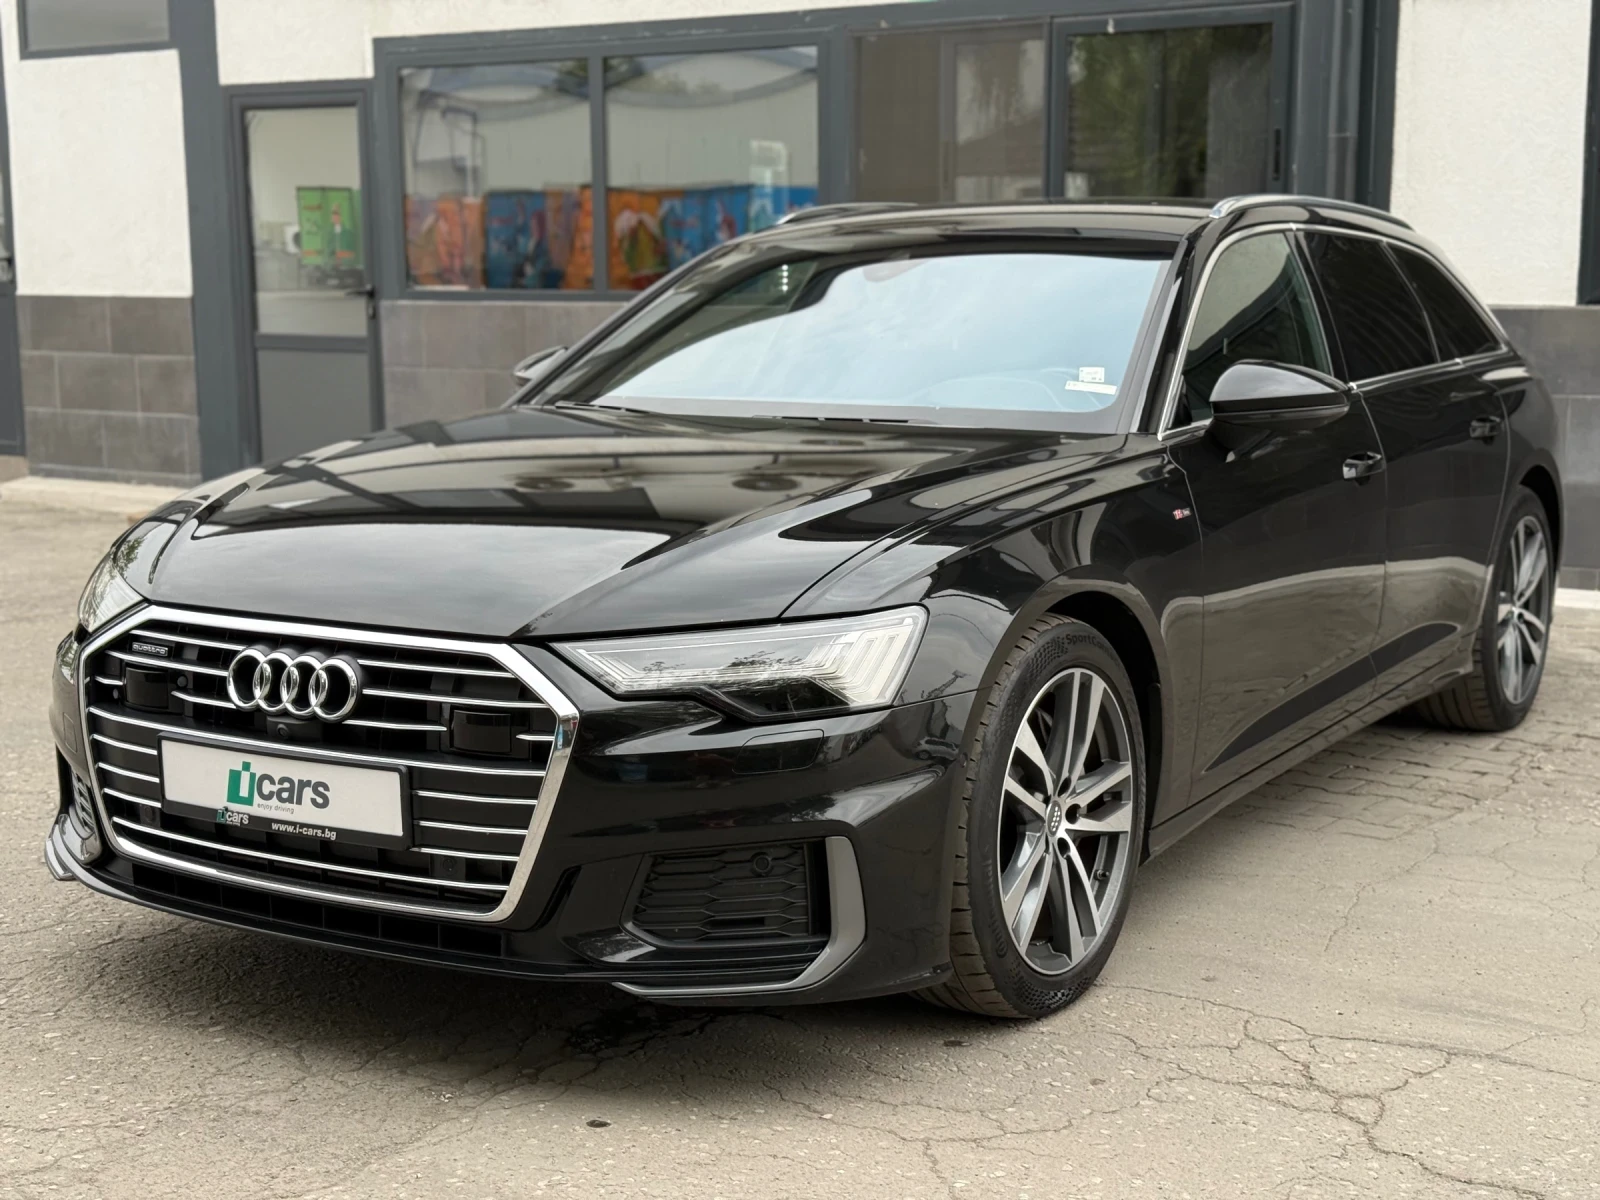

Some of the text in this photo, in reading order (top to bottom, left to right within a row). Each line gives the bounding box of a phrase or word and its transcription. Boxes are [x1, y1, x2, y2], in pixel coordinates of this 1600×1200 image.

[132, 644, 166, 655] quattro
[257, 803, 295, 815] enjoy driving
[271, 822, 337, 840] www.i-cars.bg
